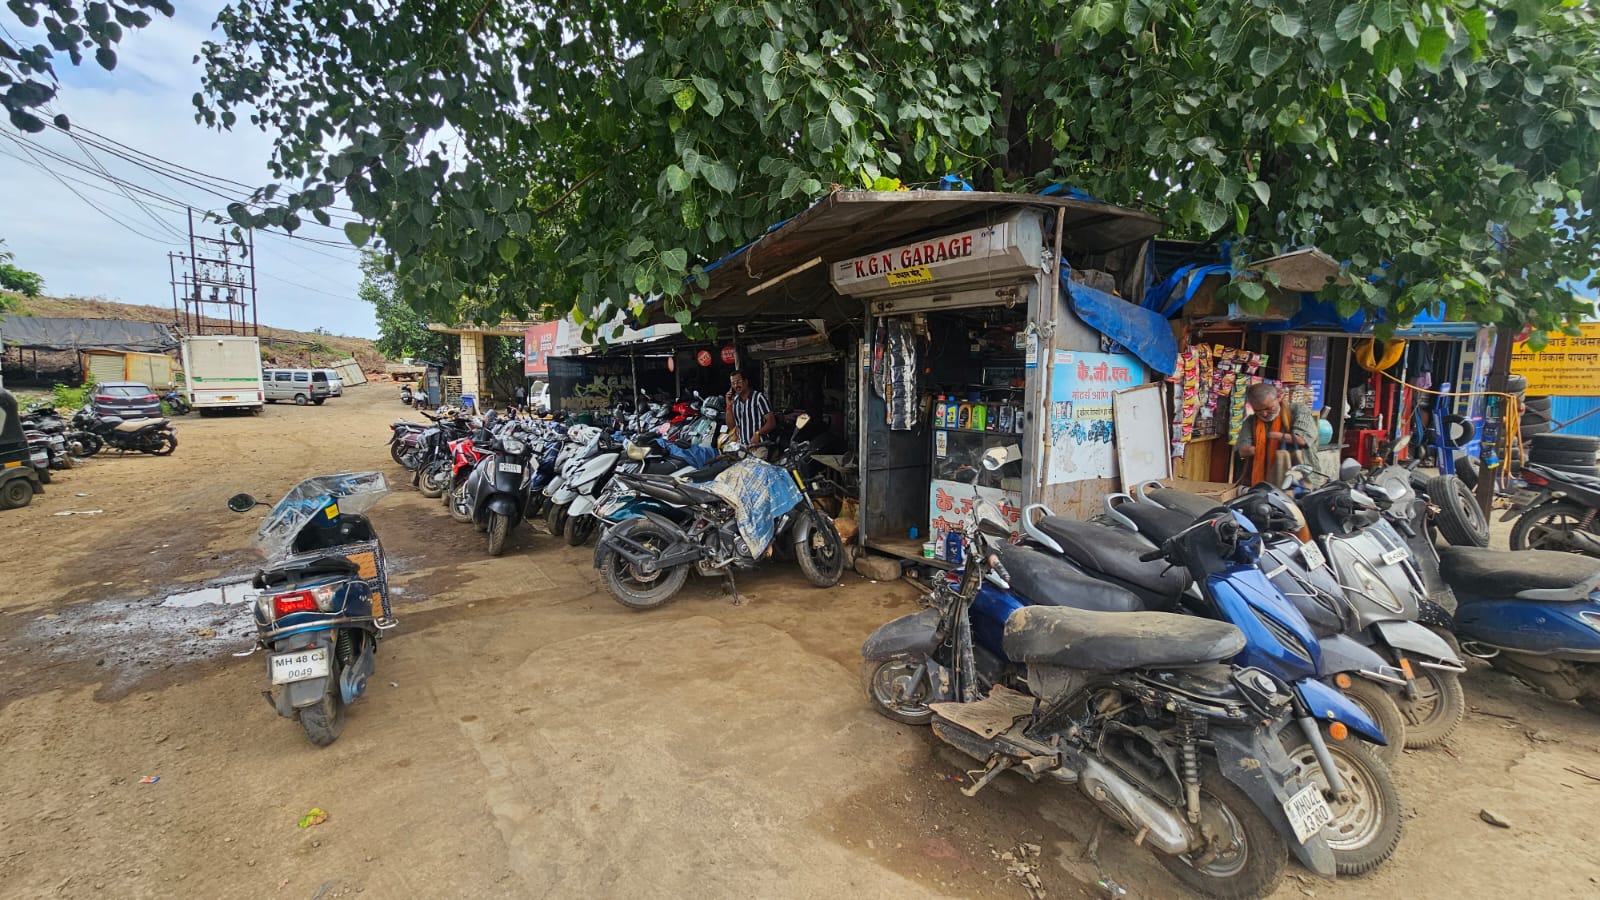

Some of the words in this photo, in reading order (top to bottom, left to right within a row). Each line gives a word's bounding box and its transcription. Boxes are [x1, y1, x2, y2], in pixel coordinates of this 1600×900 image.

[855, 253, 897, 278] K.G.N.
[902, 236, 972, 269] GARAGE
[275, 658, 292, 667] MH
[296, 655, 308, 664] 48
